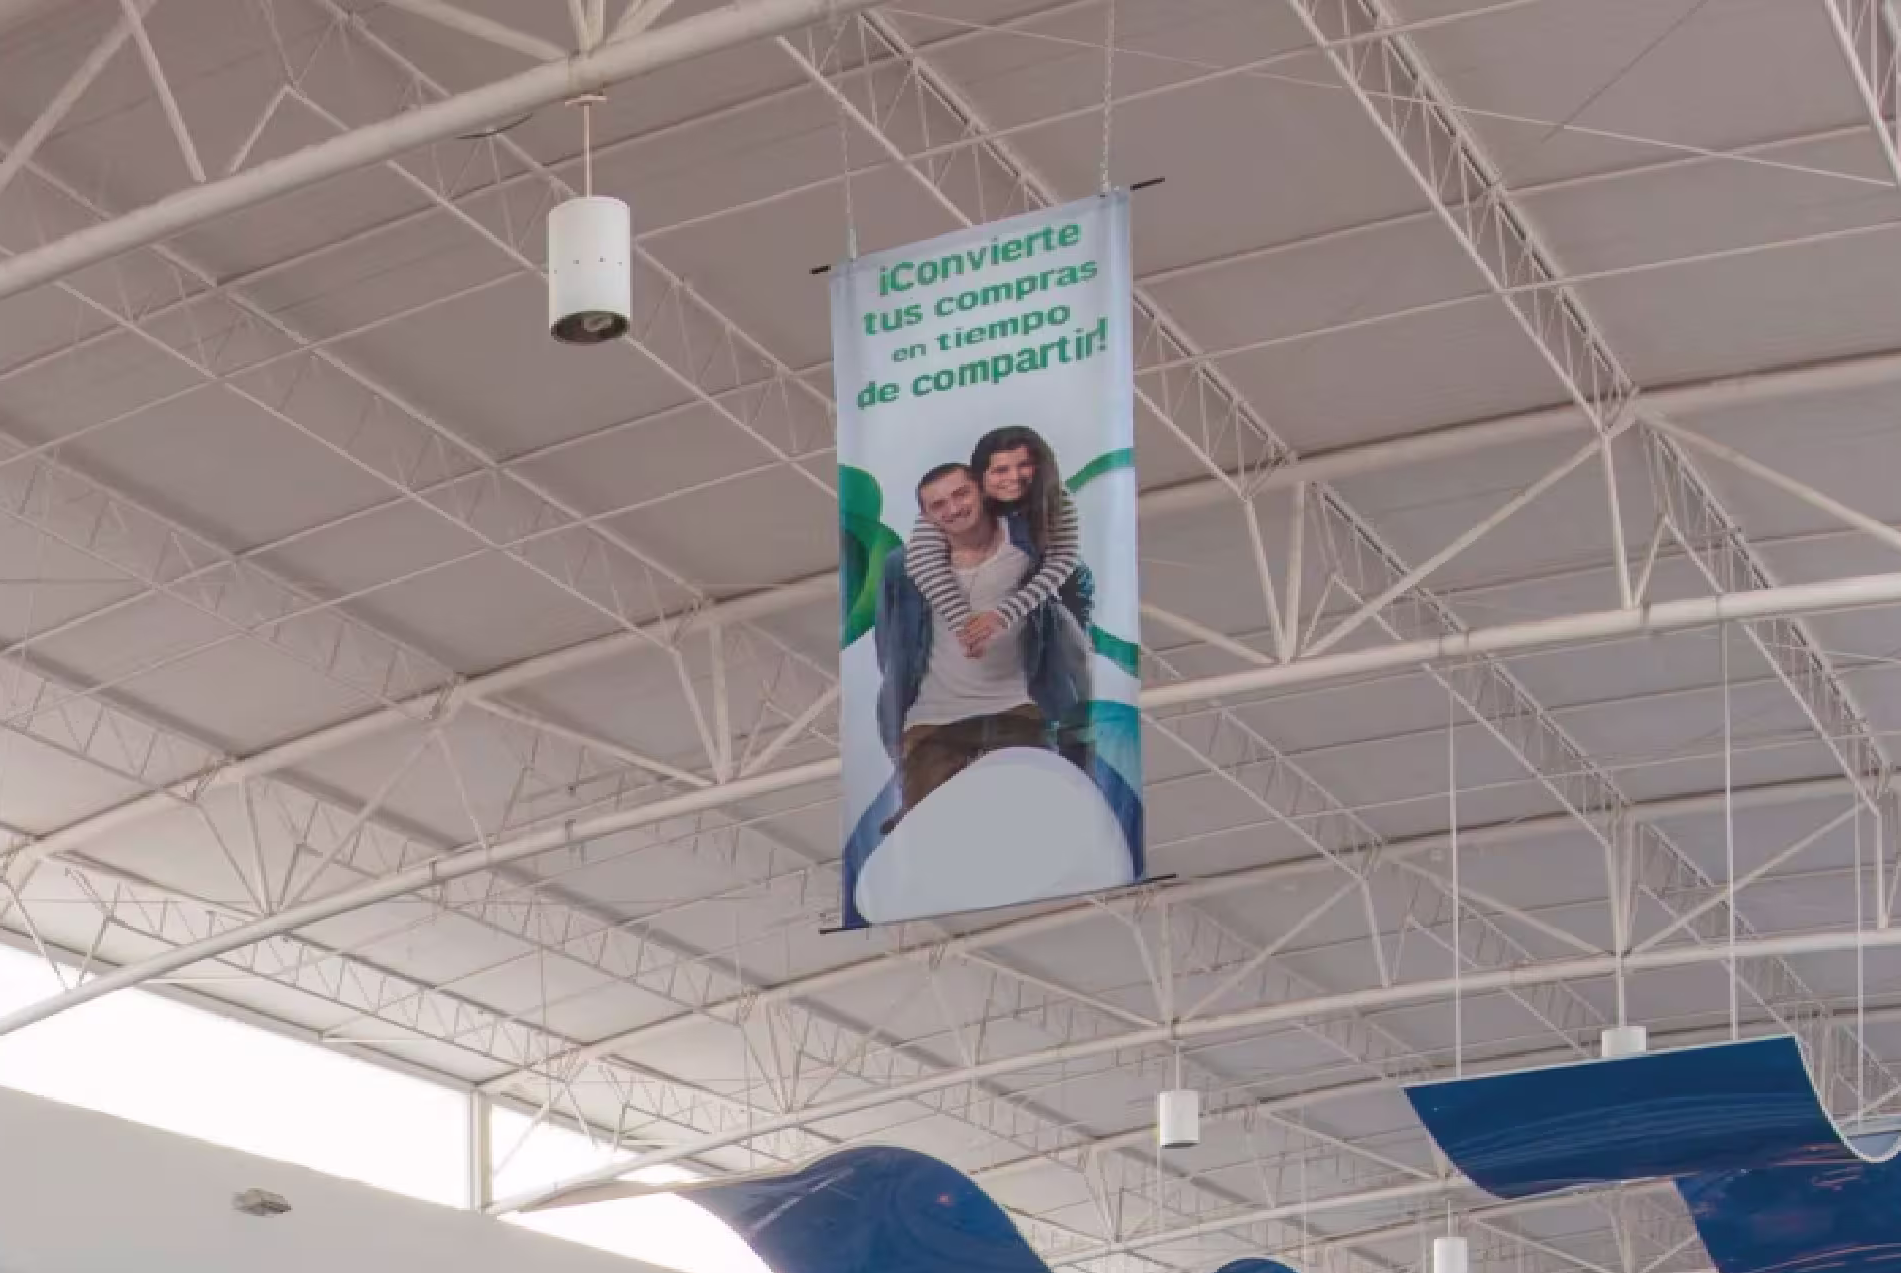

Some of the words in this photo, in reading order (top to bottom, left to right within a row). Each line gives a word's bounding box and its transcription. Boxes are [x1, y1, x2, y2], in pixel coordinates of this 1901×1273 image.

[878, 222, 1082, 296] ¡Convierte
[863, 302, 923, 335] tus
[934, 259, 1098, 316] compras
[891, 342, 927, 363] en
[934, 304, 1071, 352] tiempo
[856, 381, 900, 410] de
[911, 315, 1109, 397] compartir!
